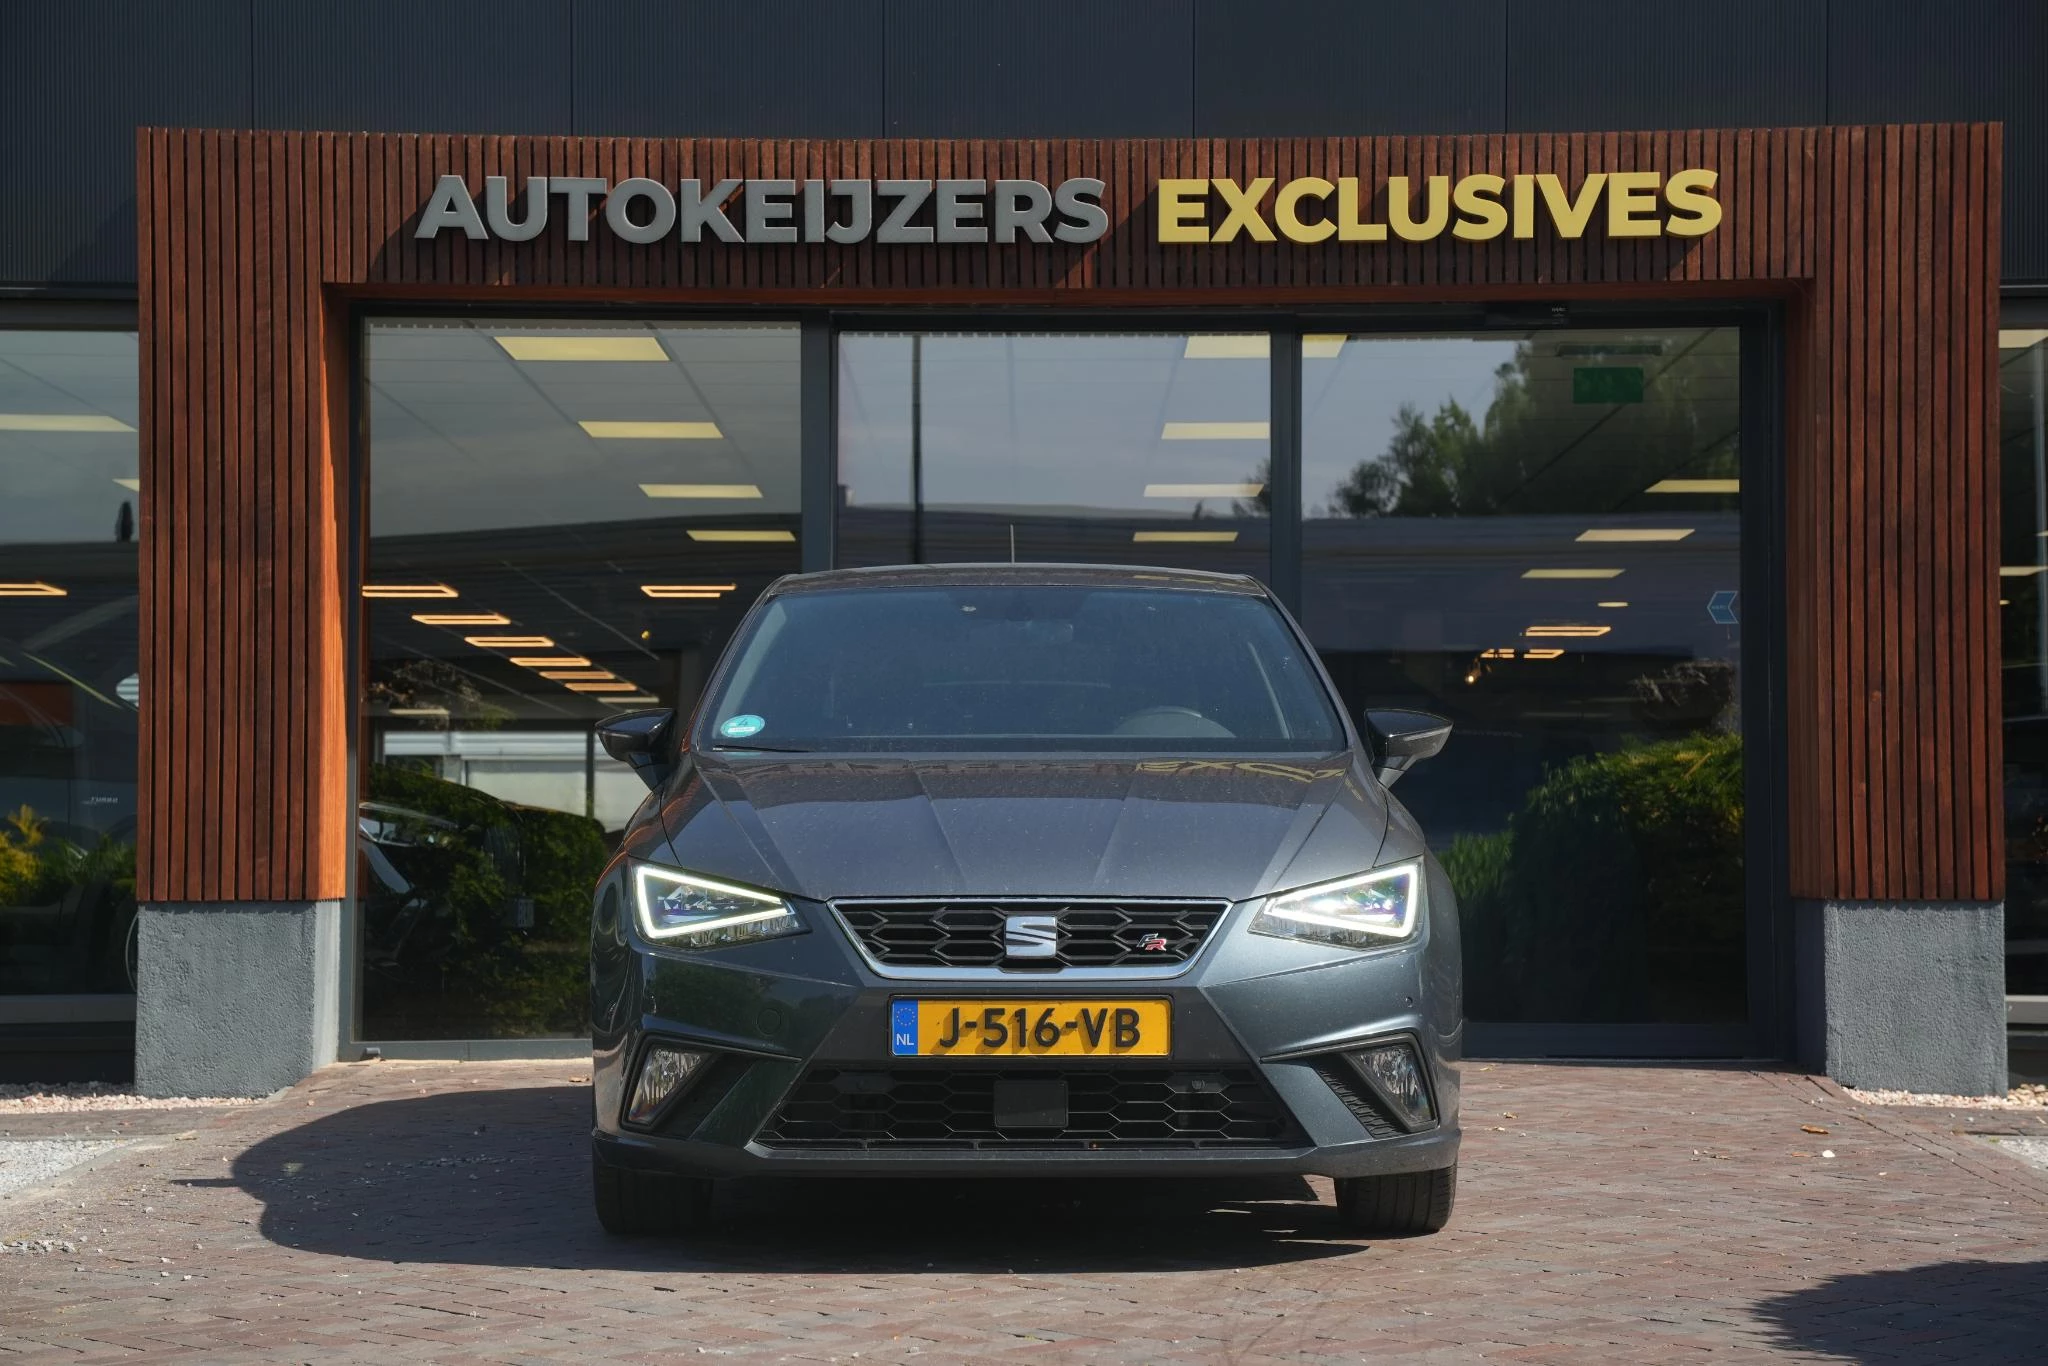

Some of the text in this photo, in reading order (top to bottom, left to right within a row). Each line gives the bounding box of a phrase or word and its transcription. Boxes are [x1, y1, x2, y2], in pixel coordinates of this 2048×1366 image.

[414, 169, 1723, 244] AUTOKEIJZERS EXCLUSIVES
[896, 1033, 914, 1046] NL
[939, 1008, 1141, 1048] J-516-VB
